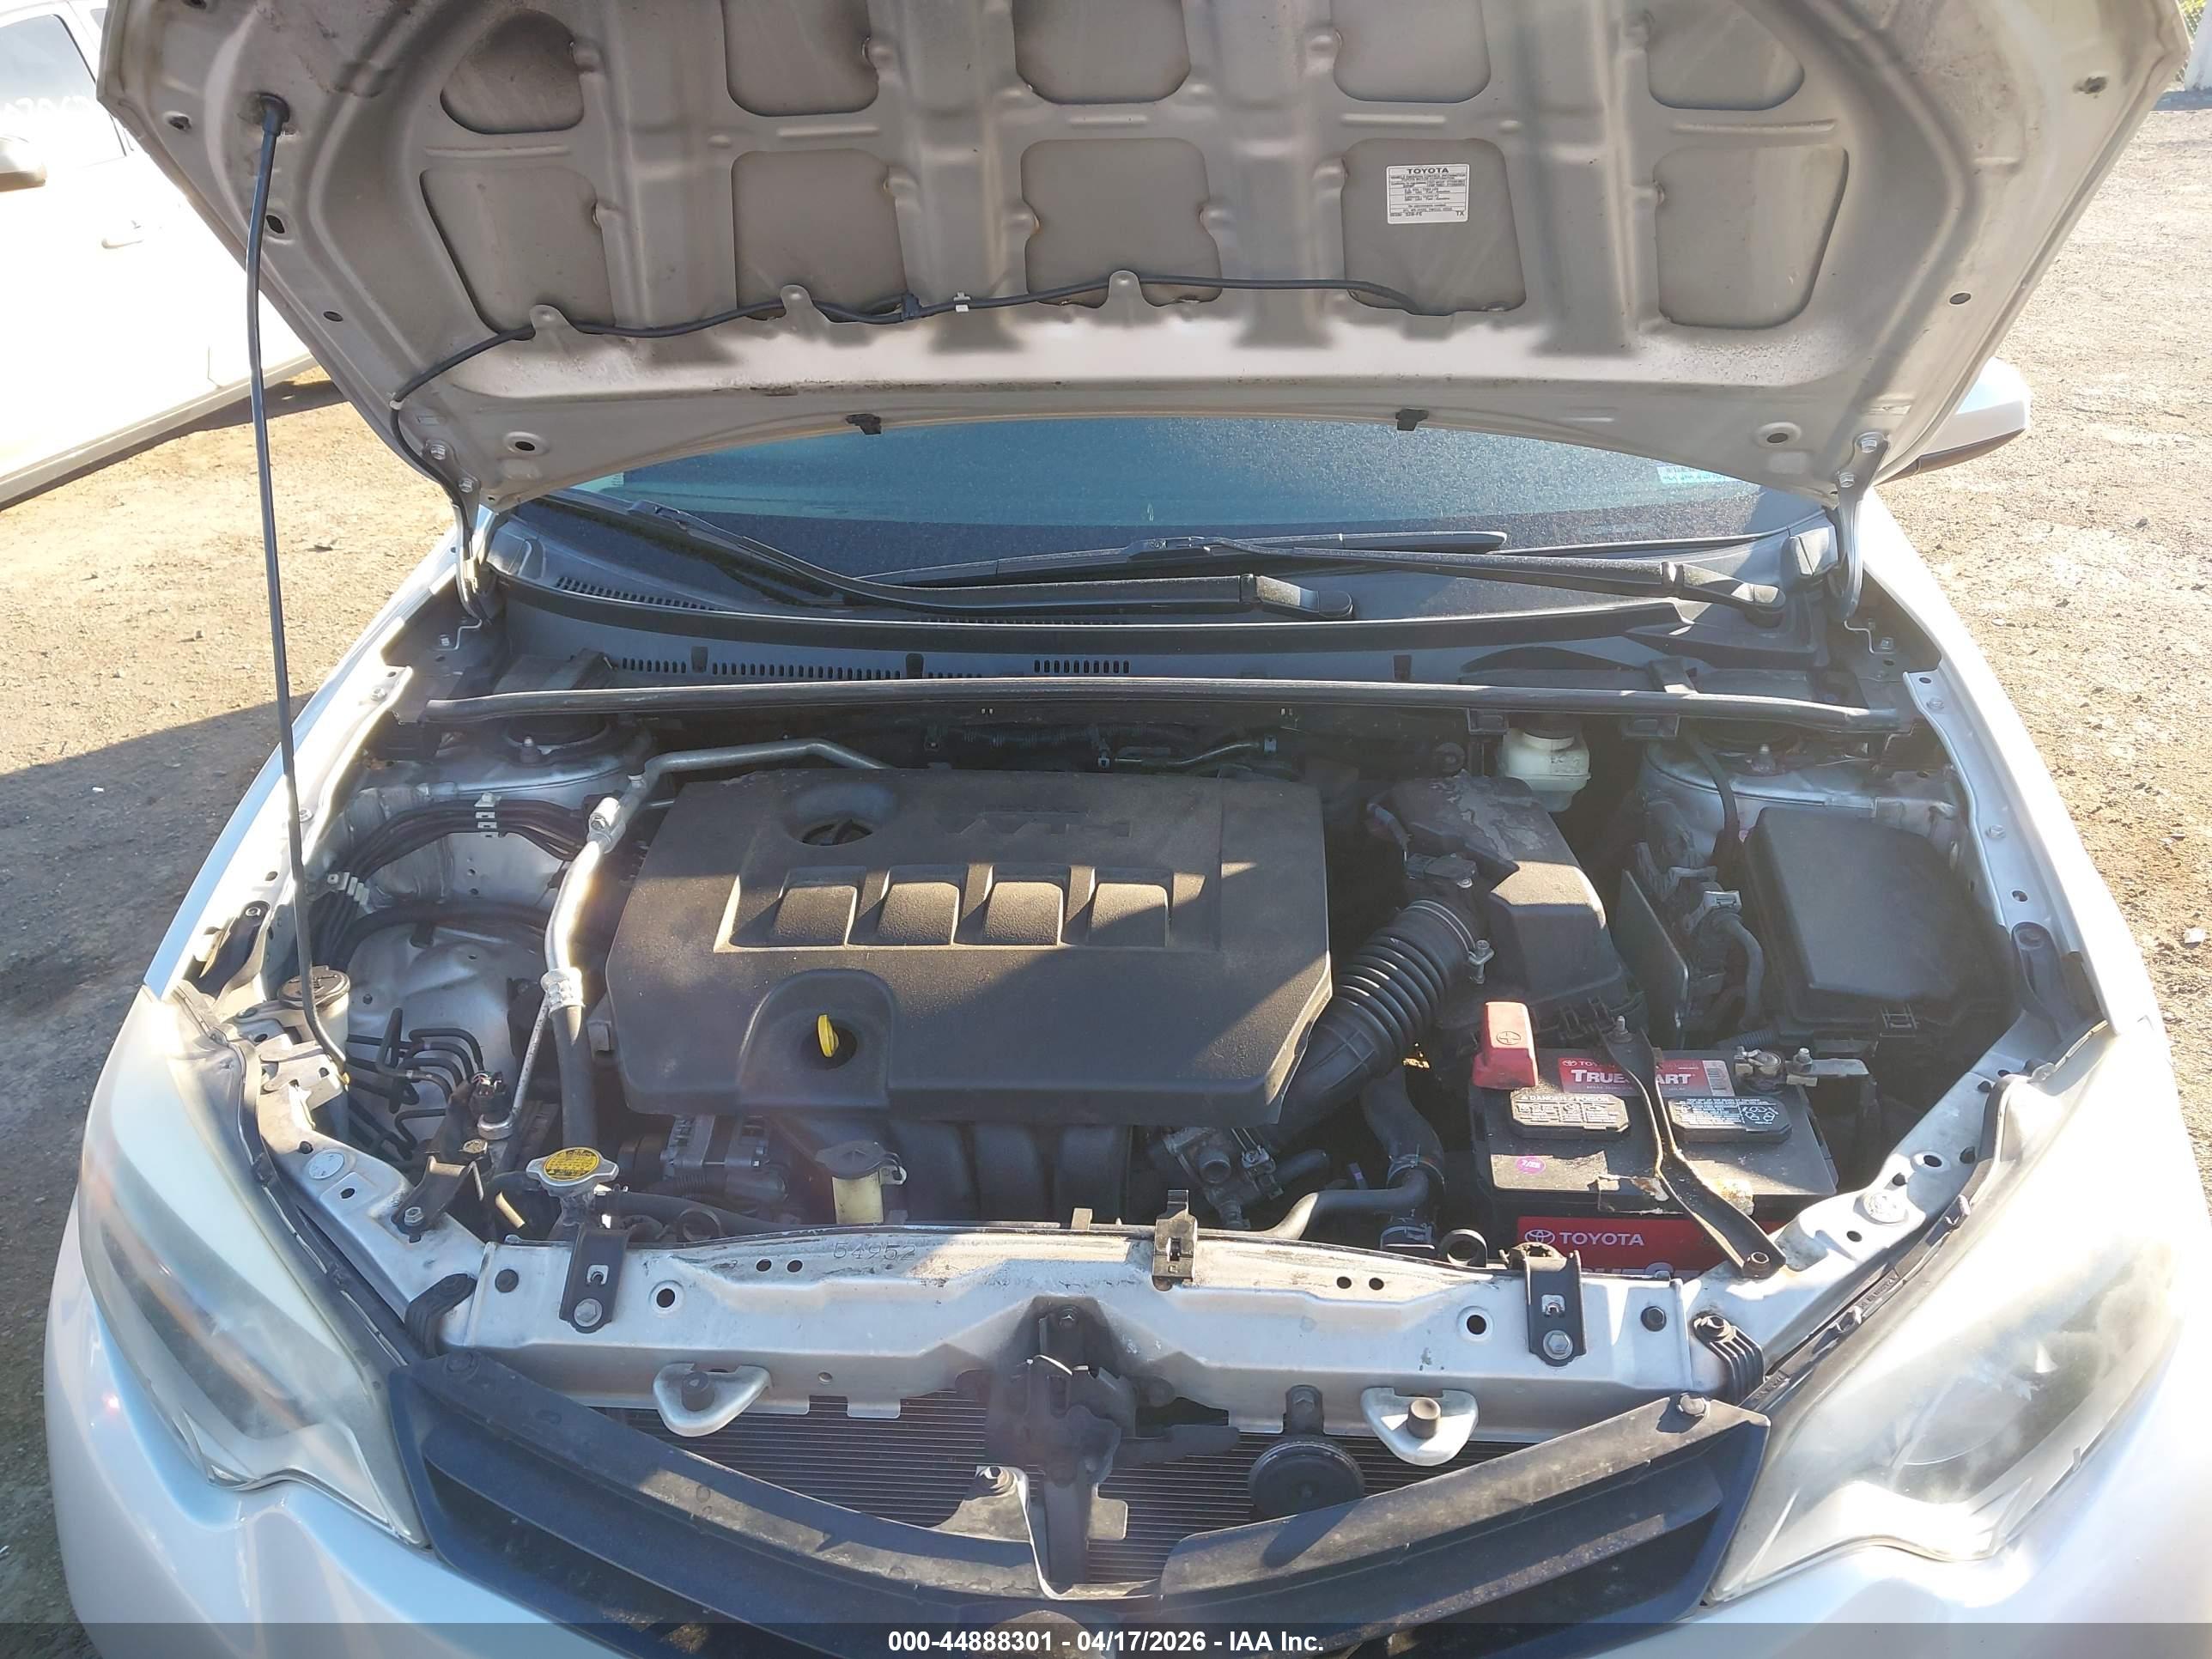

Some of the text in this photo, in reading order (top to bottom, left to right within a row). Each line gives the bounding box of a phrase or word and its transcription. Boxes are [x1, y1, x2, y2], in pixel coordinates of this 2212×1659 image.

[1571, 1069, 1692, 1085] TRUEART
[1559, 1231, 1645, 1247] TOYOTA
[833, 1242, 916, 1260] 54952
